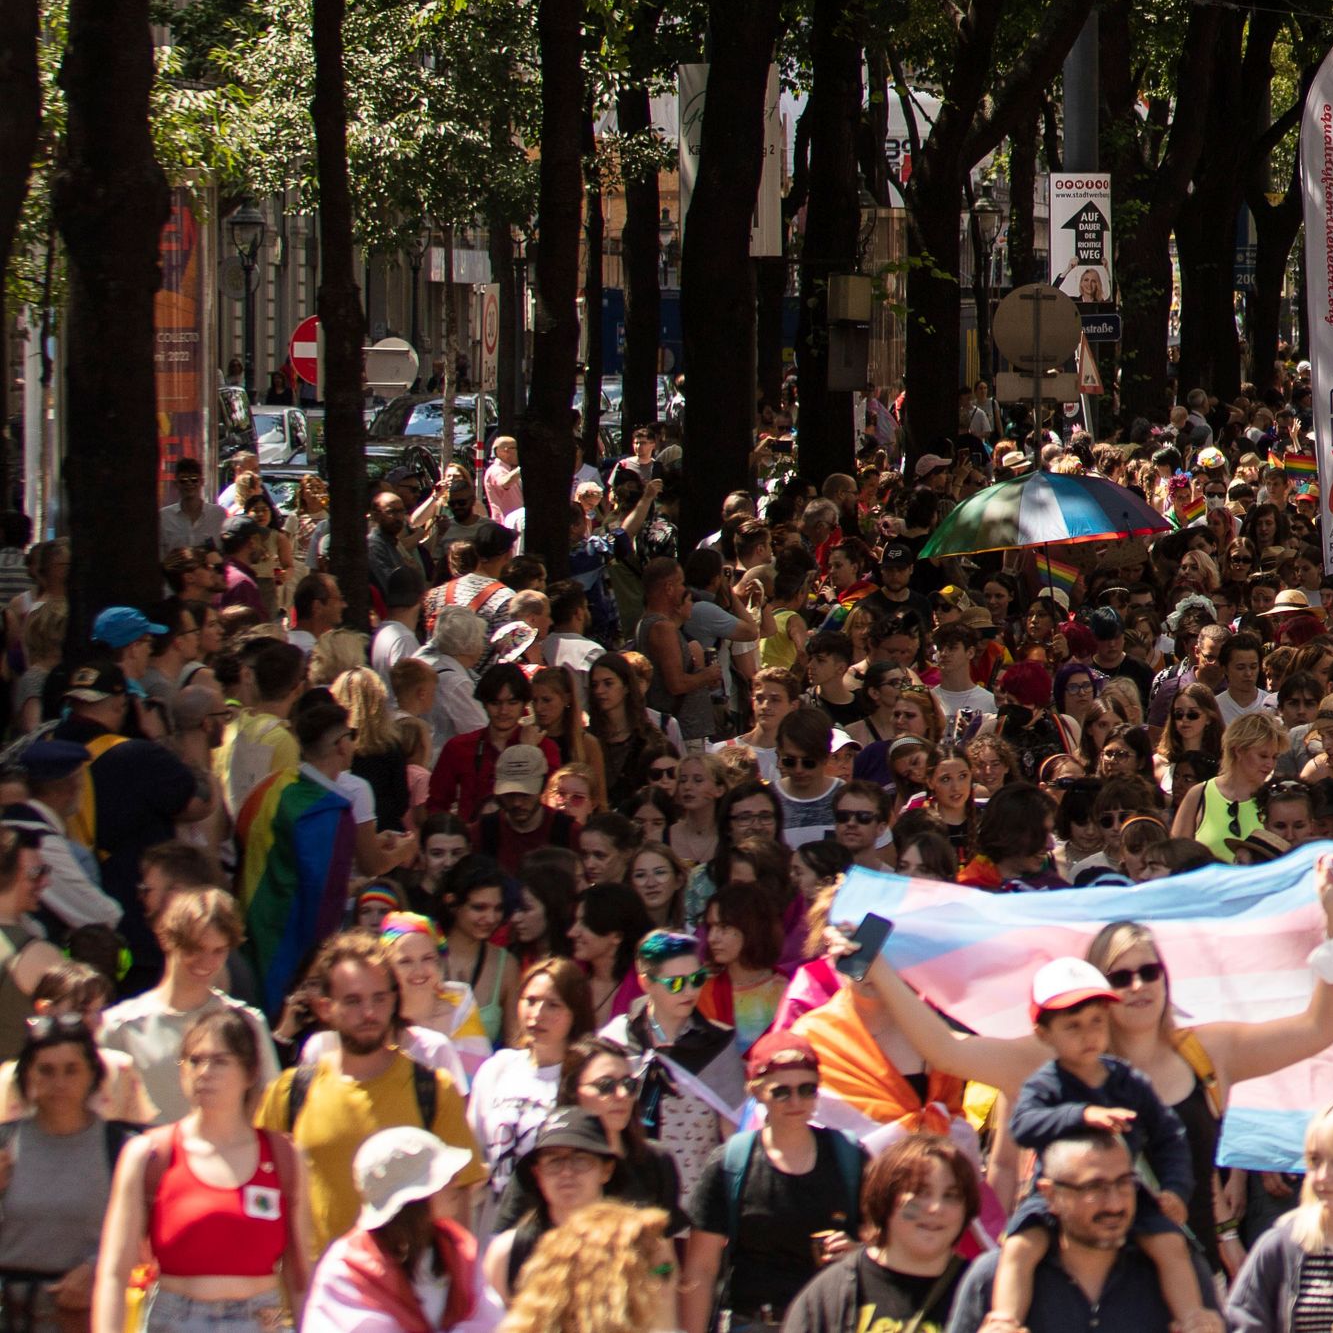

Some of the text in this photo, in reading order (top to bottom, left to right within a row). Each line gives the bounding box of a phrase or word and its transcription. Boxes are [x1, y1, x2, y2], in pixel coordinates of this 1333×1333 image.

[1080, 212, 1100, 222] AUF
[1079, 223, 1101, 231] DAUER
[1080, 249, 1101, 259] WEG
